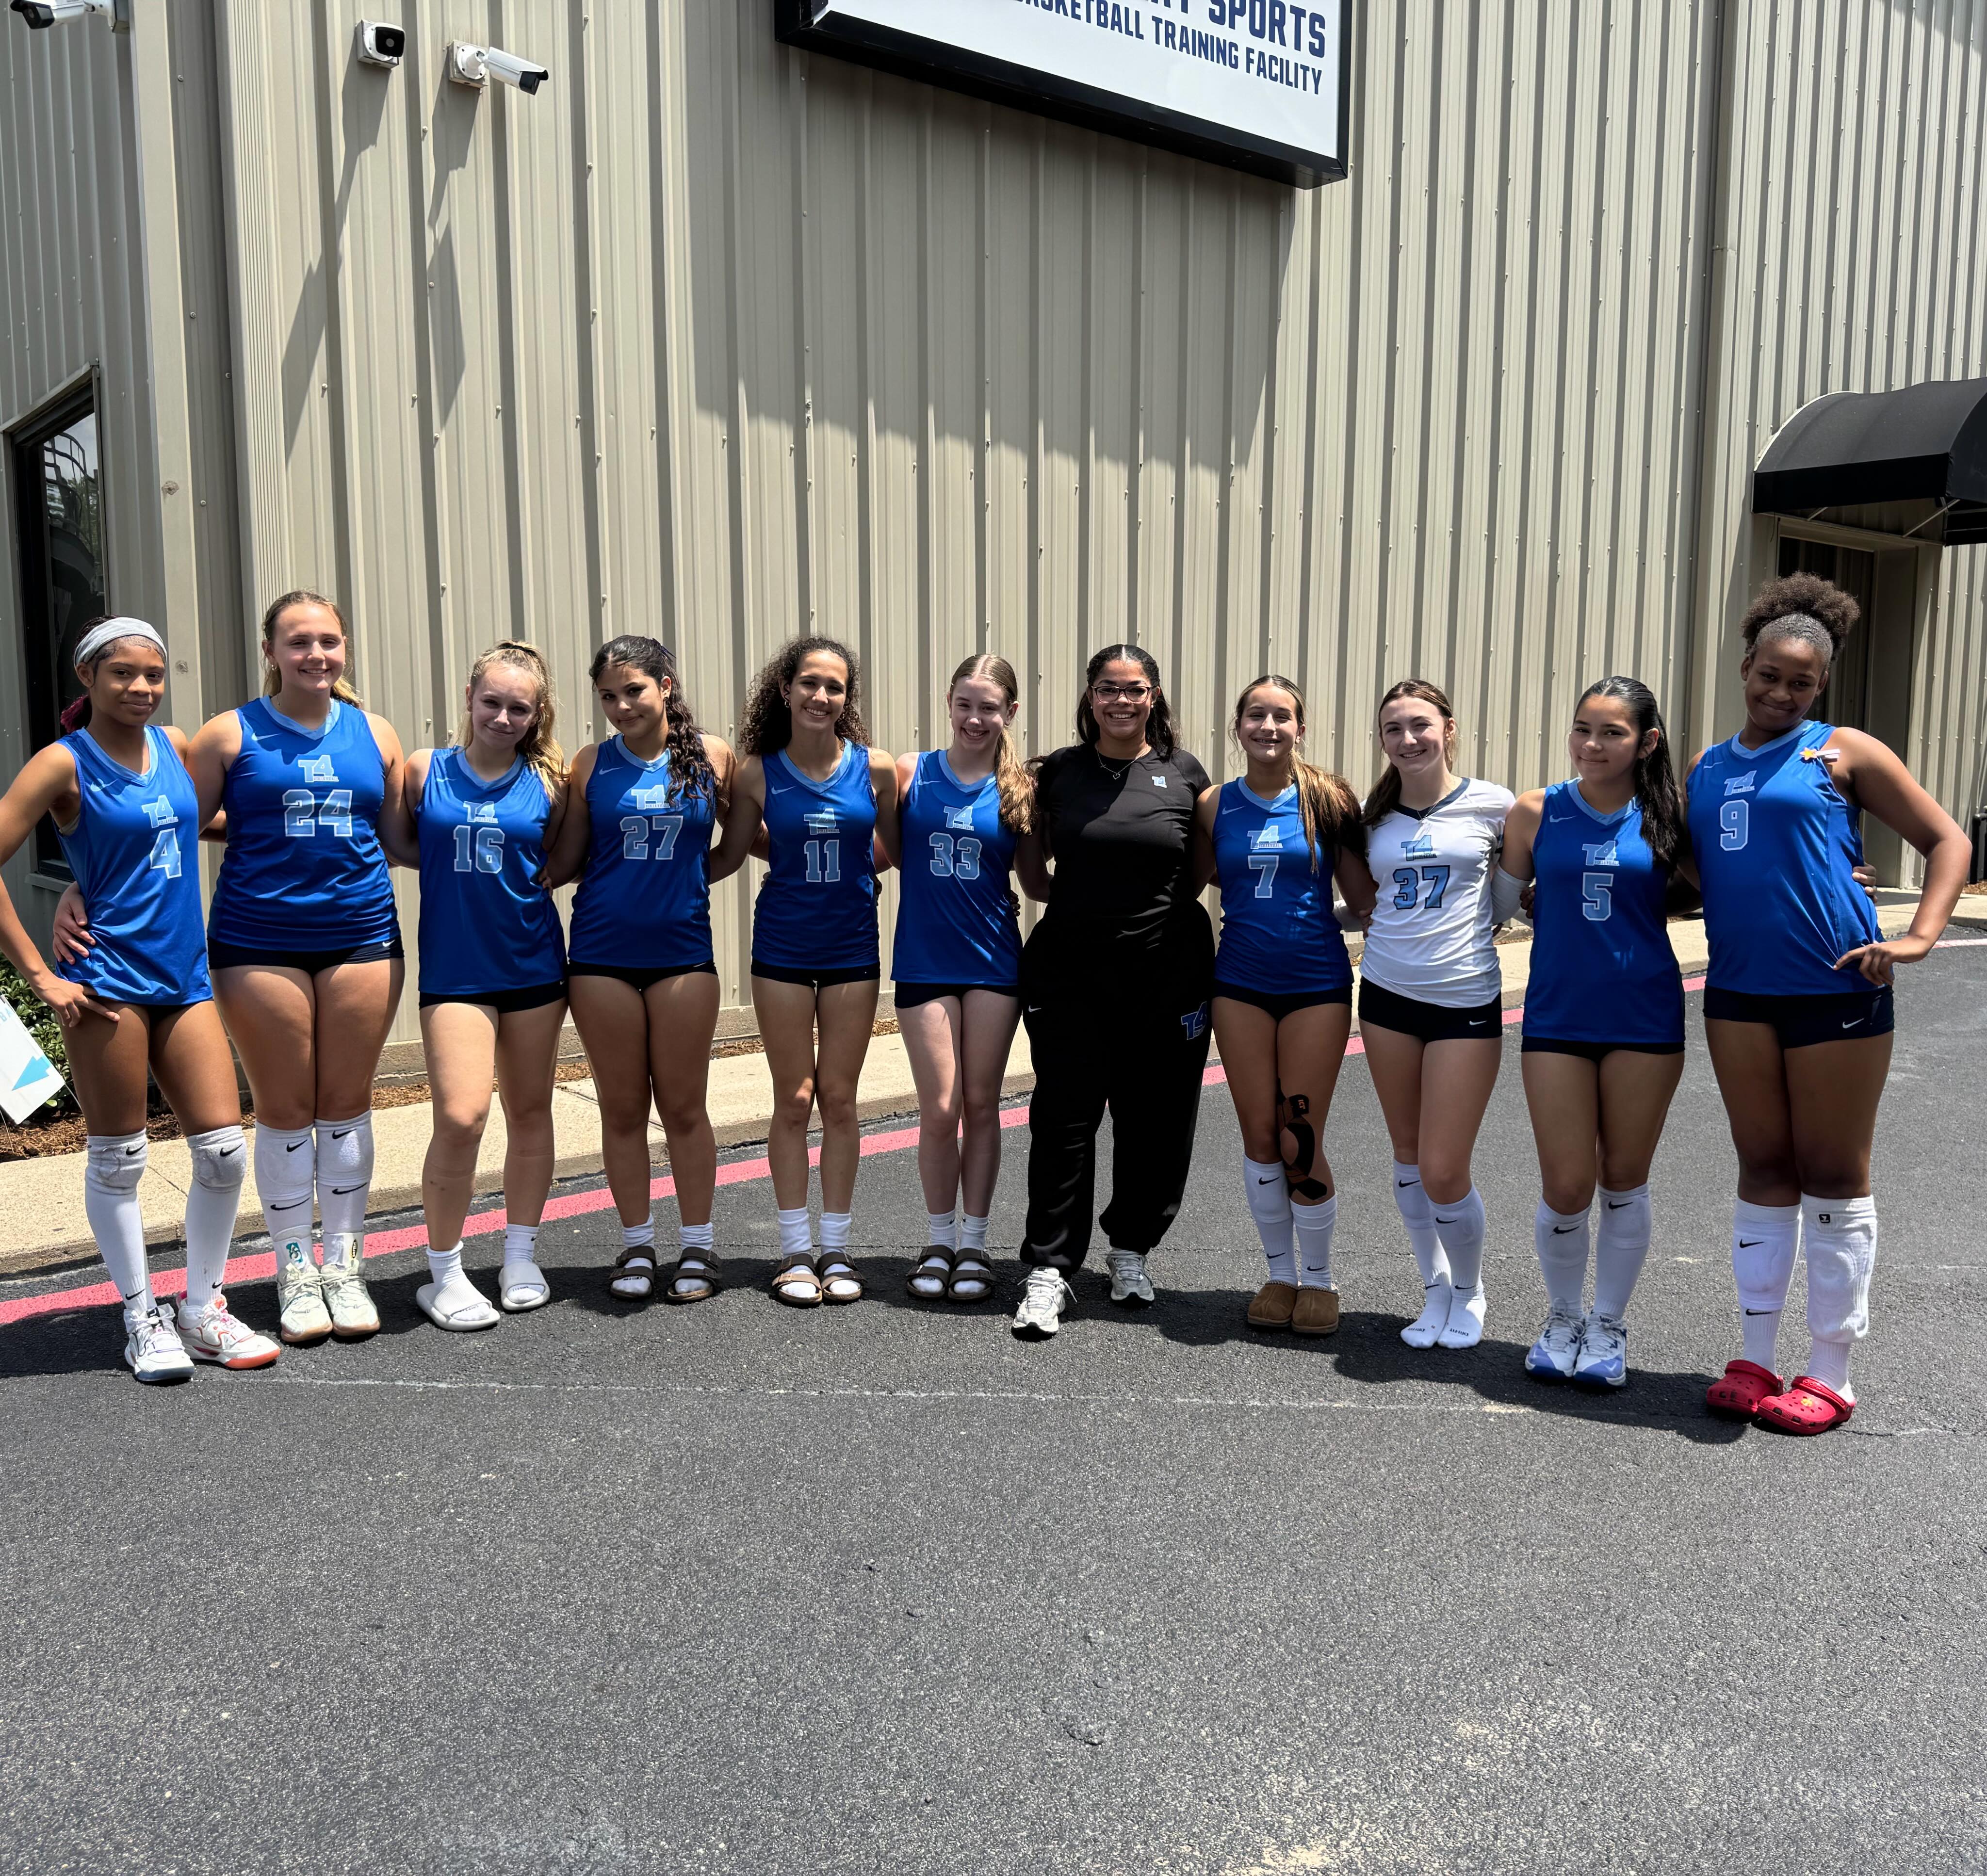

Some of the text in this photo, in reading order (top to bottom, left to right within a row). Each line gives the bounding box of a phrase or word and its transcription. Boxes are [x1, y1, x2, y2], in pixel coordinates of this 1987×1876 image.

[1208, 0, 1325, 58] SPORTS
[1152, 16, 1238, 69] TRAINING
[1246, 47, 1322, 95] FACILITY
[282, 789, 353, 837] 24
[619, 815, 684, 859] 27
[1720, 799, 1748, 851] 9
[149, 827, 182, 879] 4
[453, 825, 505, 873] 16
[804, 840, 841, 882] 11
[929, 832, 982, 880] 33
[1247, 855, 1279, 898] 7
[1392, 865, 1450, 910] 37
[1582, 872, 1614, 921] 5
